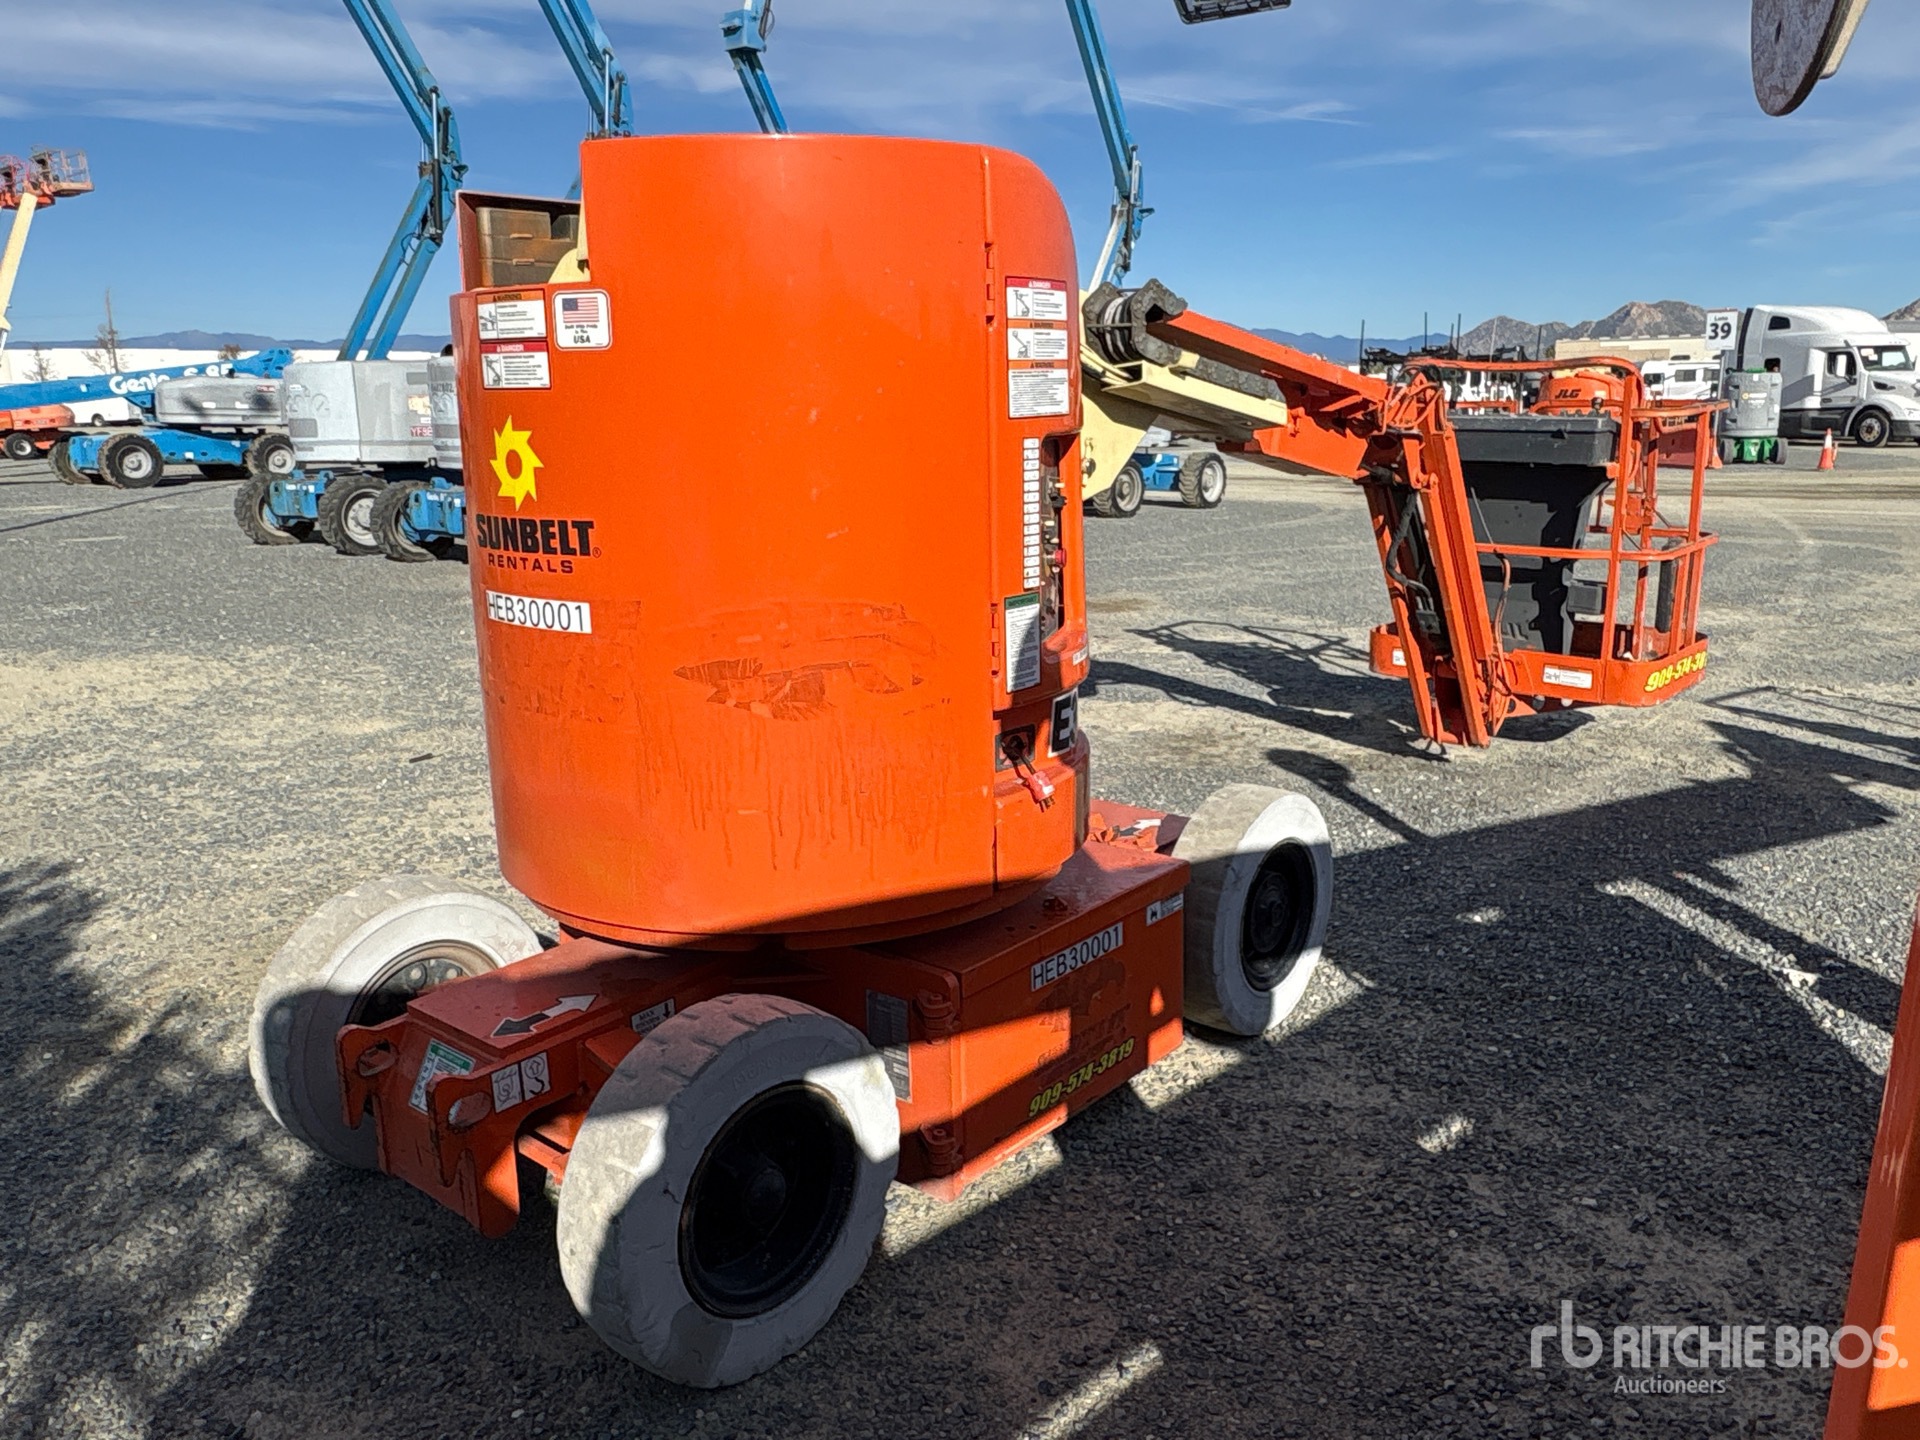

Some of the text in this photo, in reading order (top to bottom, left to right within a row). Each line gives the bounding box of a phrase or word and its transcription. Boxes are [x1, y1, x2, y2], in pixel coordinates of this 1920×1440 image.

[573, 334, 591, 344] USA
[1708, 322, 1732, 340] 39
[1554, 388, 1581, 399] JLG
[476, 513, 595, 557] SUNBELT
[488, 553, 574, 574] RENTALS
[486, 592, 584, 632] HEB30001
[1032, 926, 1121, 990] HEB30001
[1028, 1037, 1135, 1118] 909-574-3819
